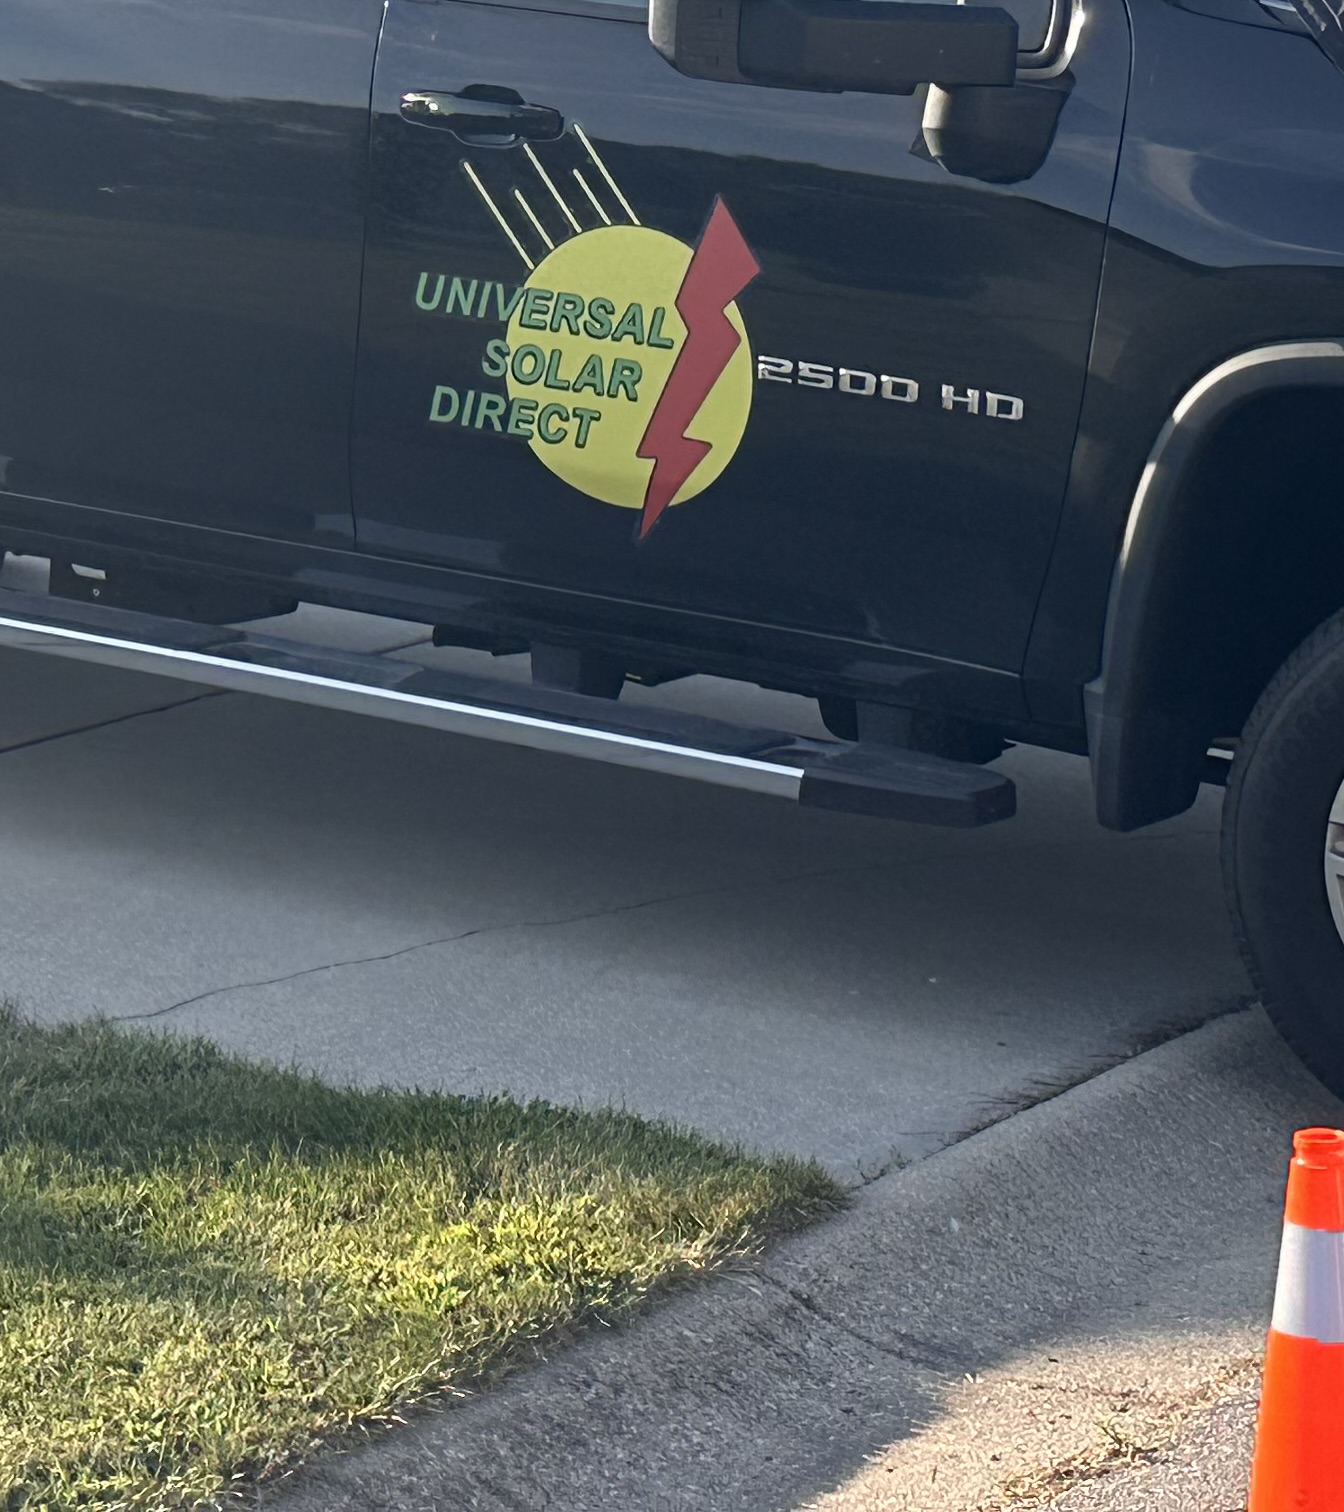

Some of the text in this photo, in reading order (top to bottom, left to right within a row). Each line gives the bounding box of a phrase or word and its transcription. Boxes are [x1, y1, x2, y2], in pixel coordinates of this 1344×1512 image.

[415, 271, 676, 350] UNIVERSAL
[481, 338, 643, 402] SOLAR
[757, 355, 1025, 422] 2500 HD
[428, 384, 601, 450] DIRECT
